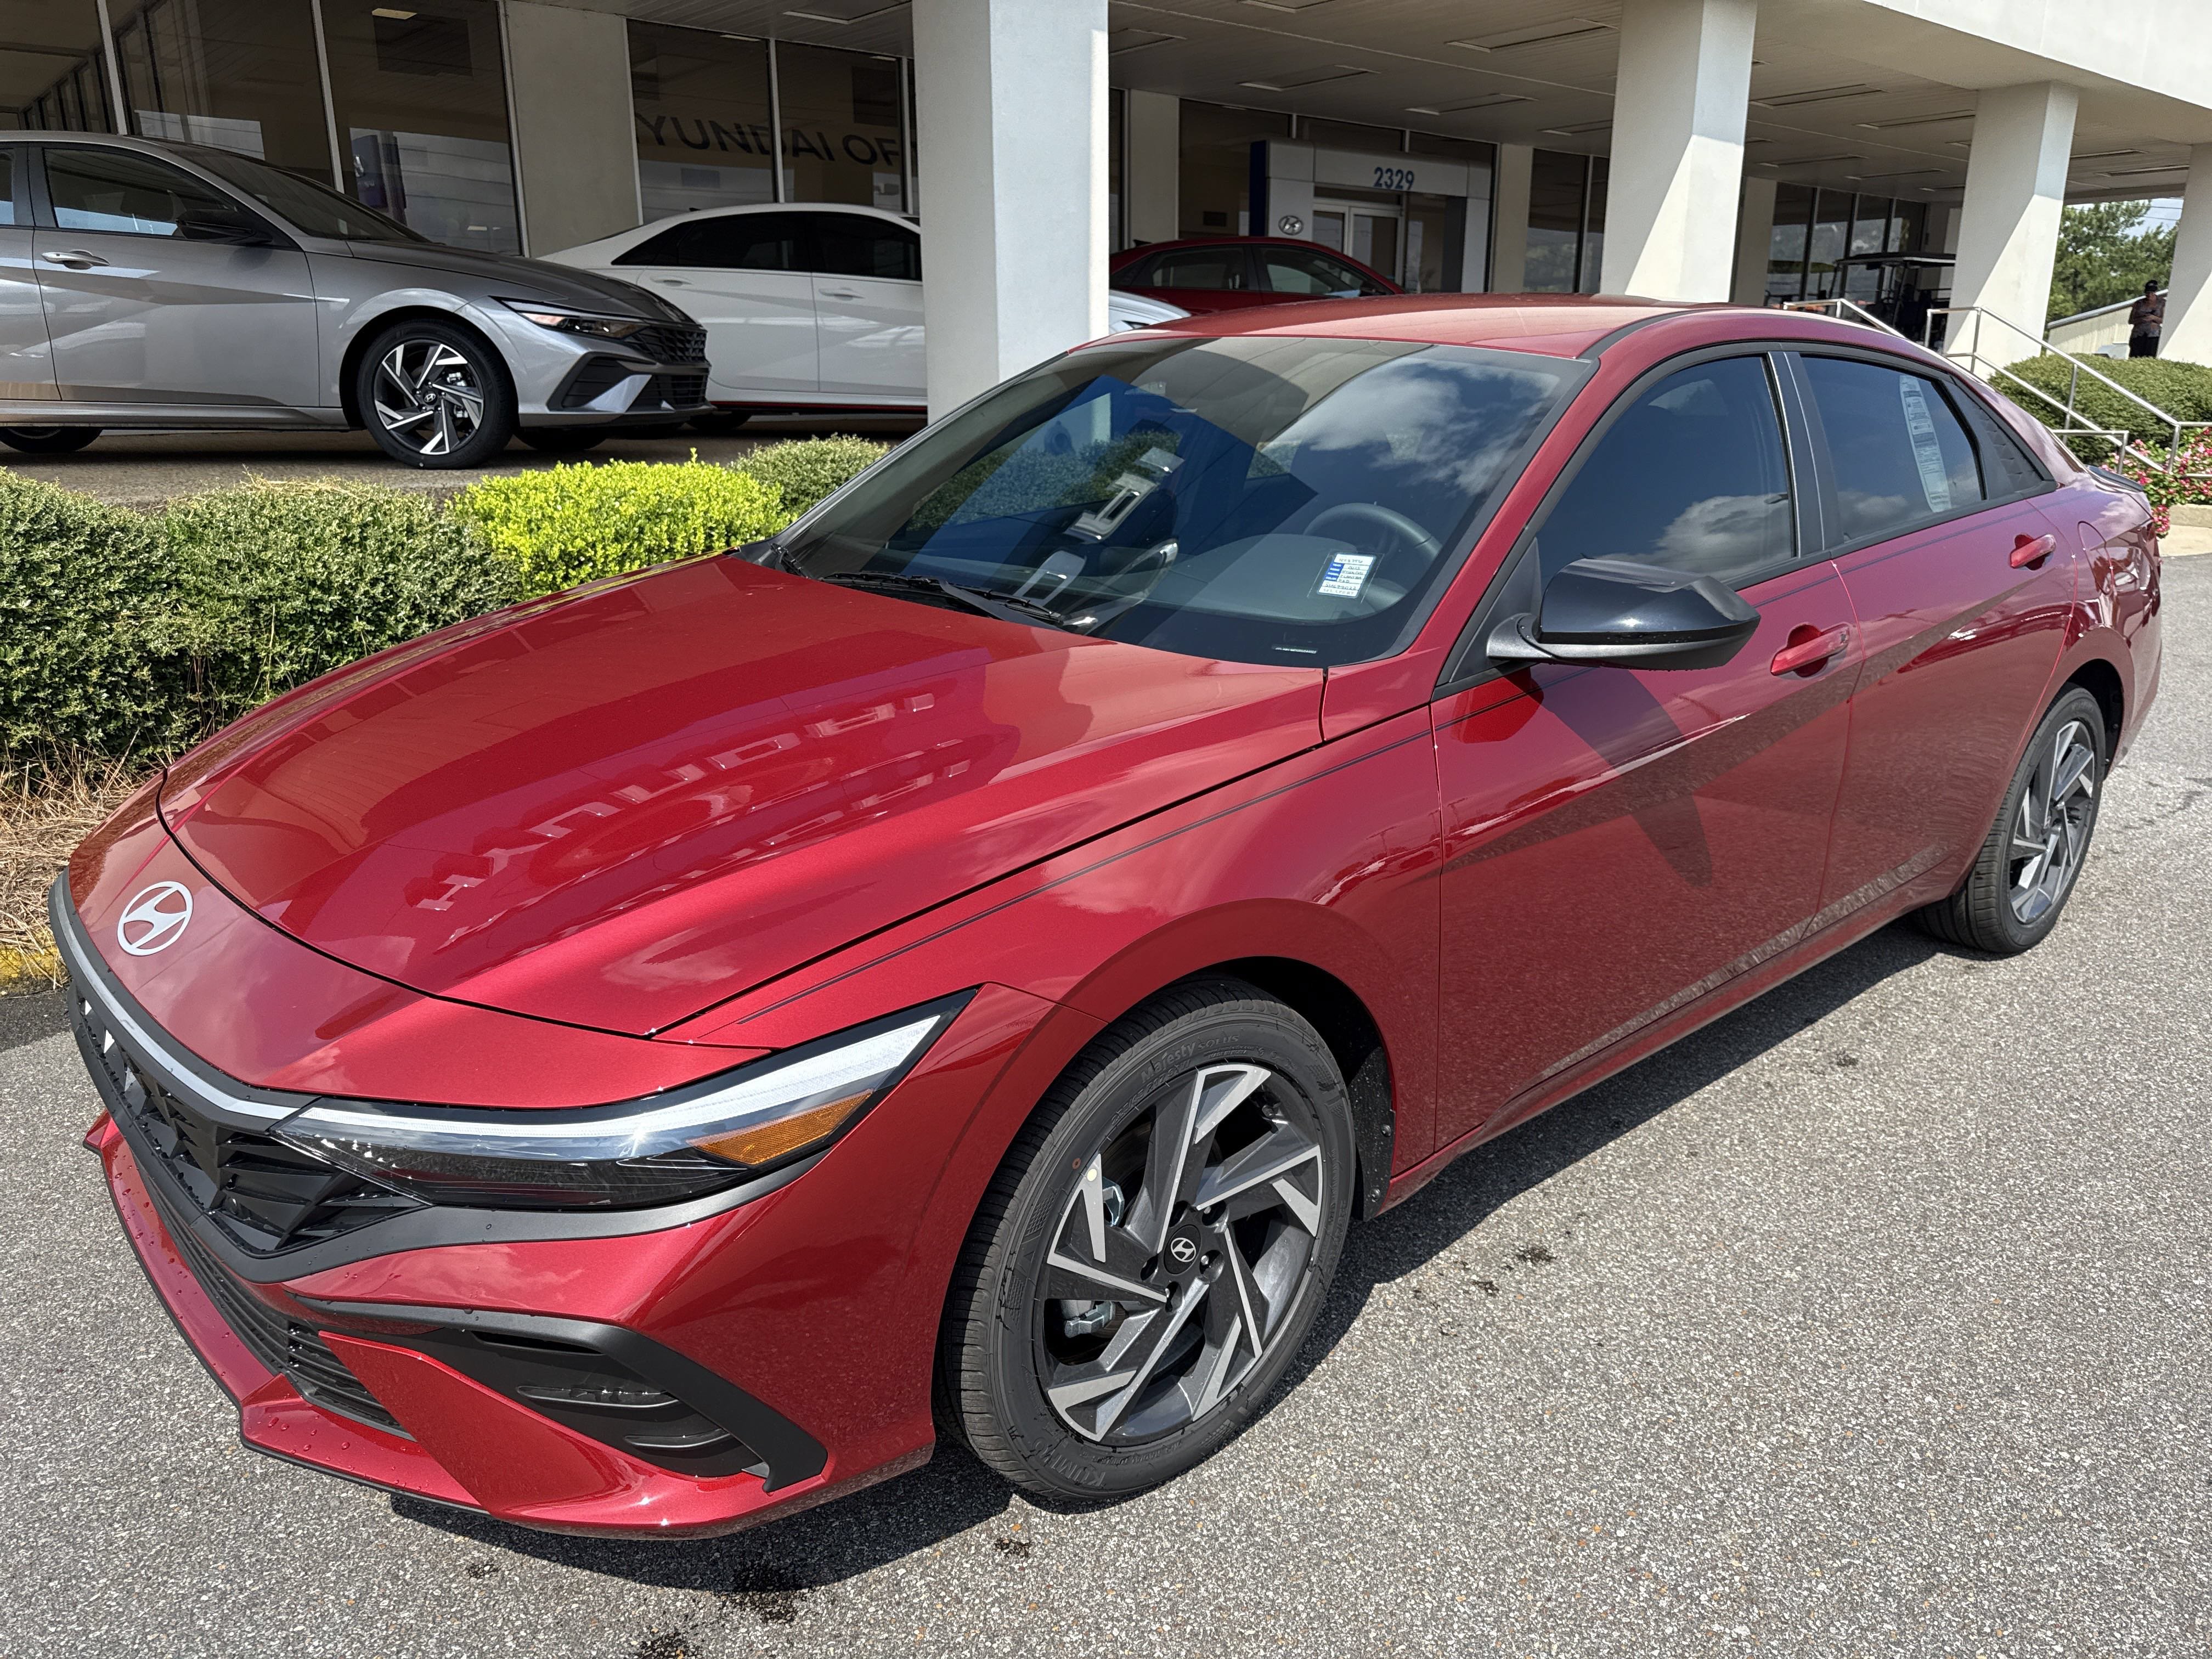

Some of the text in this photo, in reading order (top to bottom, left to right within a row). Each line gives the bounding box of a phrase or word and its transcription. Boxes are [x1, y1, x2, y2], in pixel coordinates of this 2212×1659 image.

[635, 112, 900, 166] YUNDAI OF
[1373, 166, 1414, 191] 2329
